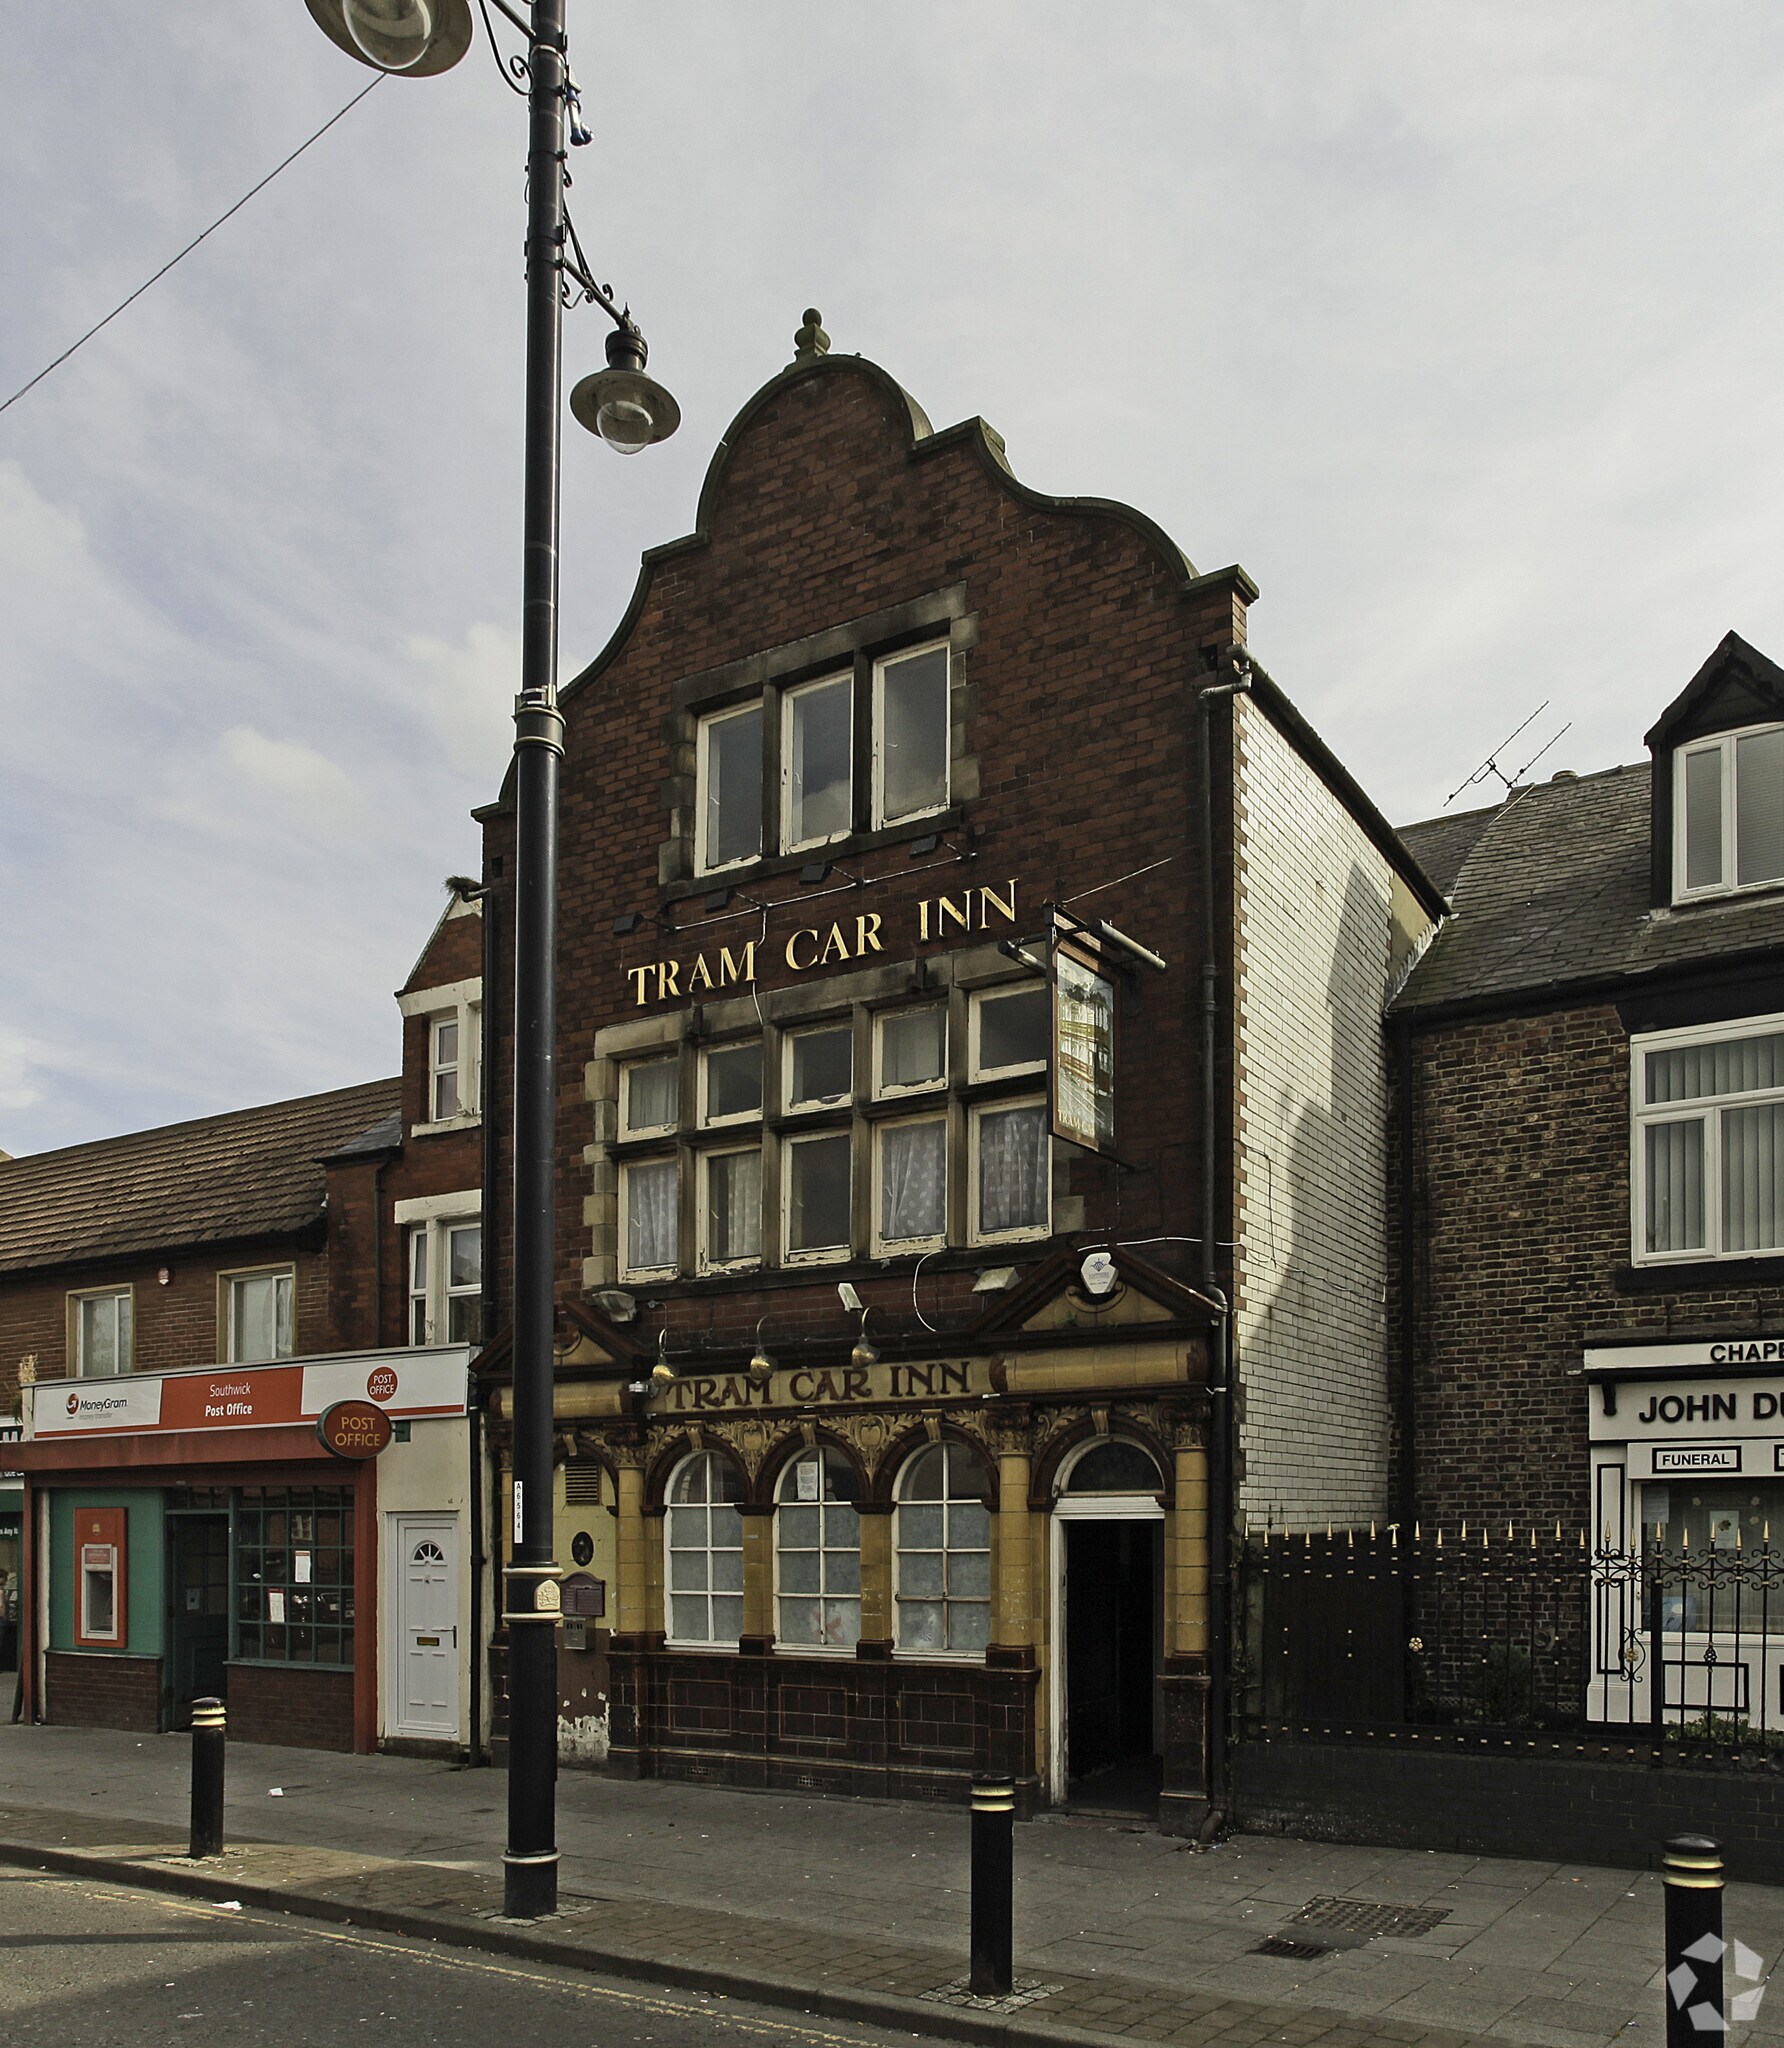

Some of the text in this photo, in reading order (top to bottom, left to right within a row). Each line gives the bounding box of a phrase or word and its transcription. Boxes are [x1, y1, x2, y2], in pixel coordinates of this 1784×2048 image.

[628, 941, 758, 1006] TRAM
[785, 913, 885, 971] CAR
[918, 878, 1019, 942] INN
[373, 1374, 393, 1384] POST
[666, 1361, 970, 1410] TRAM CAR INN
[209, 1382, 251, 1397] Southwick
[369, 1384, 394, 1395] OFFICE
[80, 1398, 127, 1412] MoneyGram
[205, 1402, 253, 1417] Post Office
[1639, 1392, 1784, 1423] JOHN D
[341, 1416, 376, 1430] POST
[335, 1432, 380, 1446] OFFICE
[1662, 1453, 1730, 1466] FUNERAL
